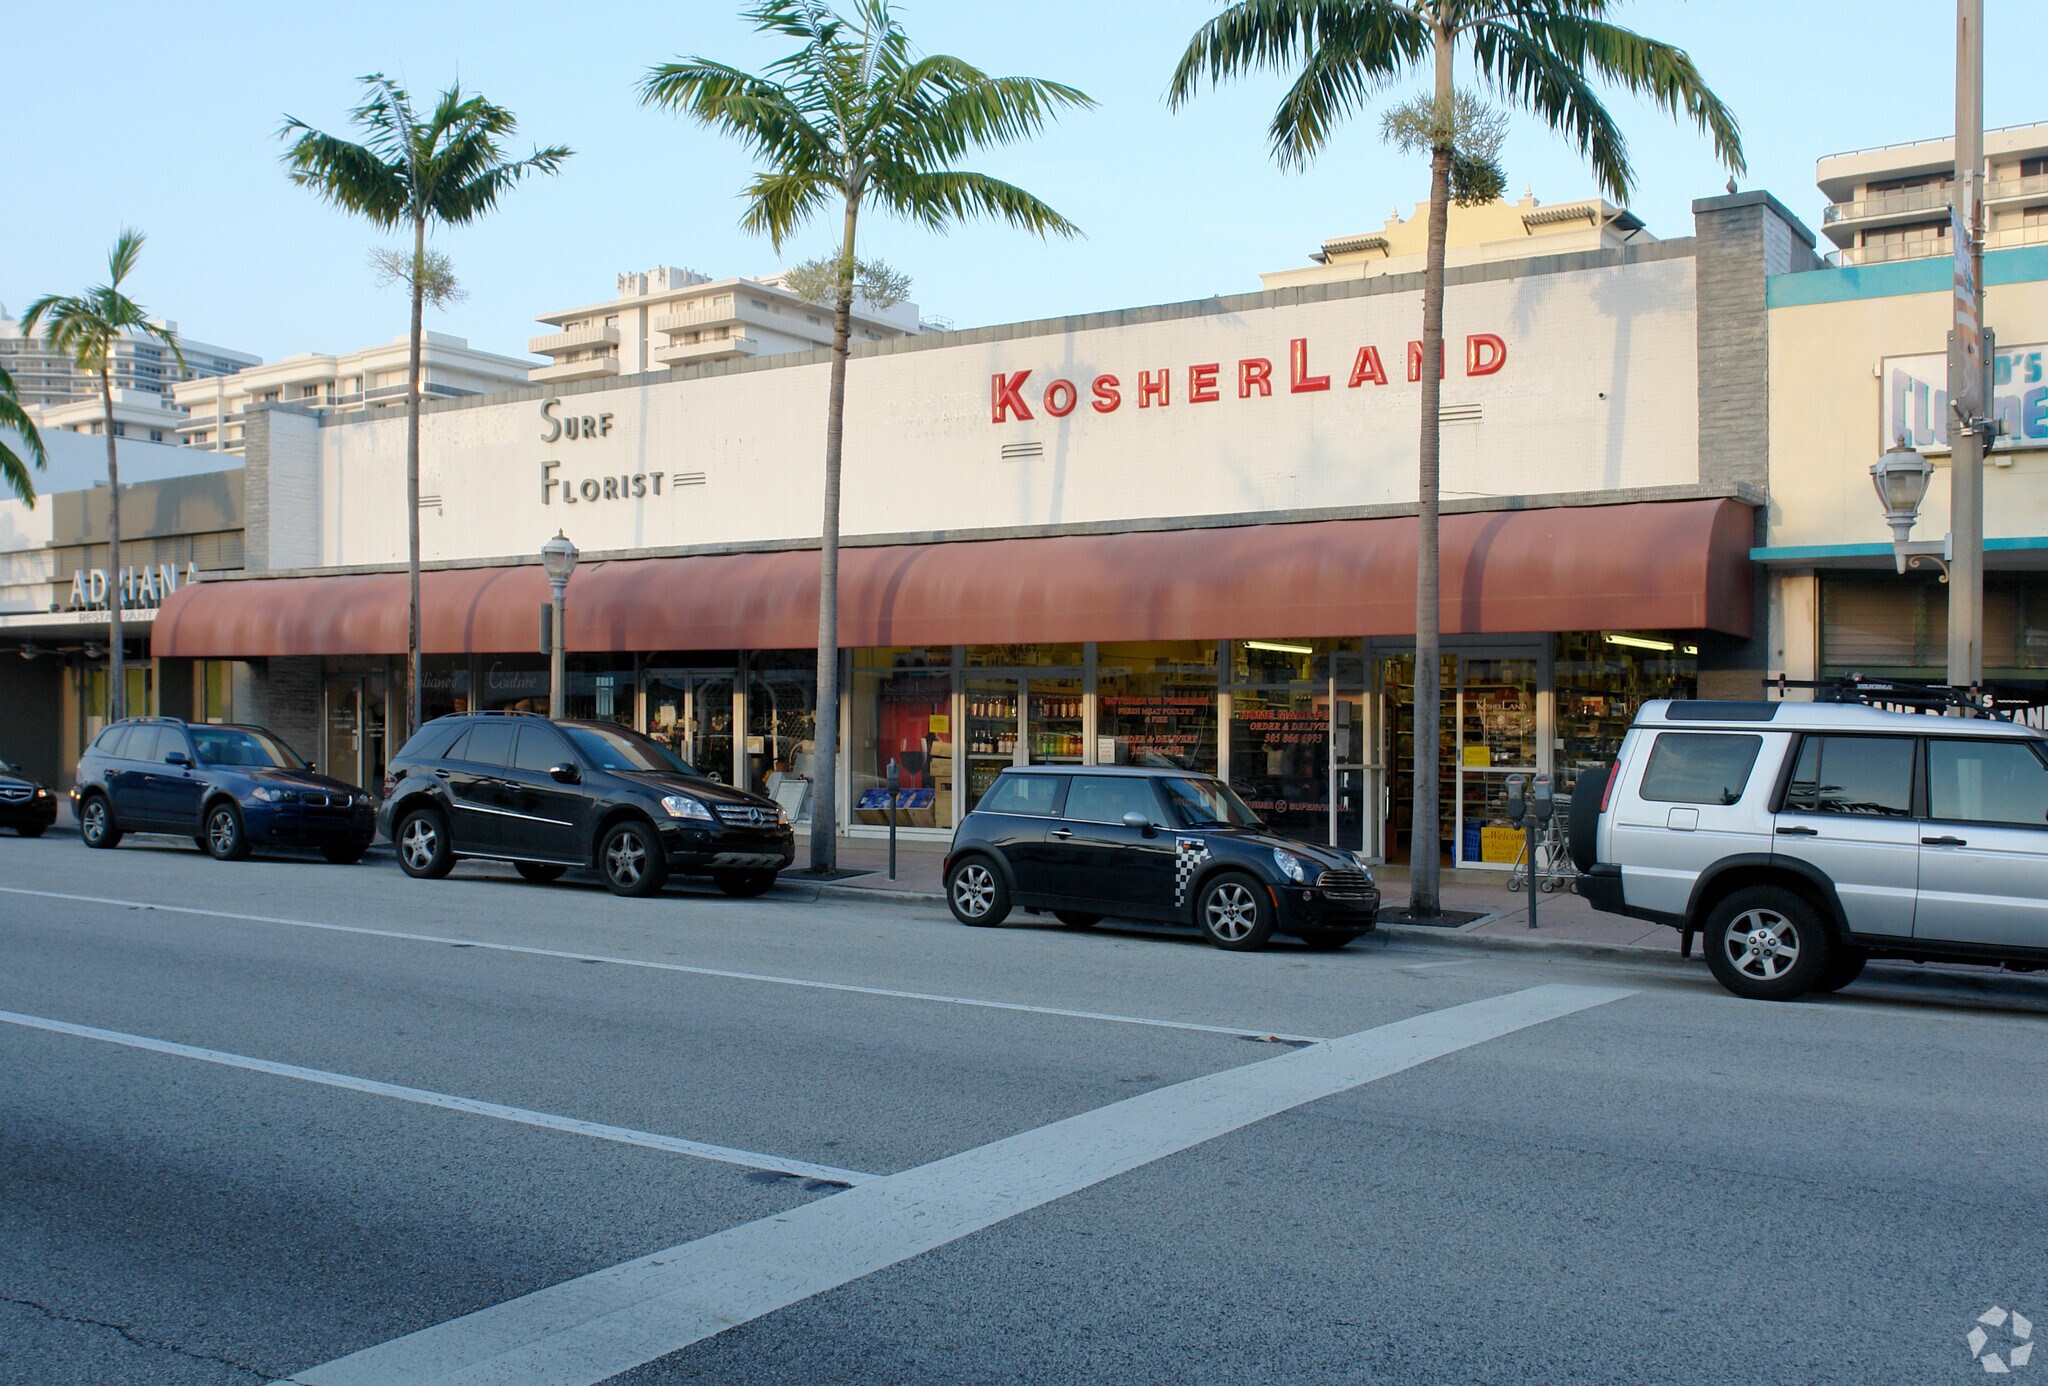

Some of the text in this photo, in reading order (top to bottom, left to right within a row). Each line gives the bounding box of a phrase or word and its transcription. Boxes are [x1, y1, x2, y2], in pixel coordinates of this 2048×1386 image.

[541, 398, 614, 442] SURF
[541, 460, 664, 505] FLORIST
[1240, 710, 1329, 720] HOME MADE FO
[1249, 722, 1281, 731] ORDER
[1291, 722, 1330, 731] DELIVER
[1264, 733, 1281, 743] 305
[1301, 733, 1323, 743] 6993
